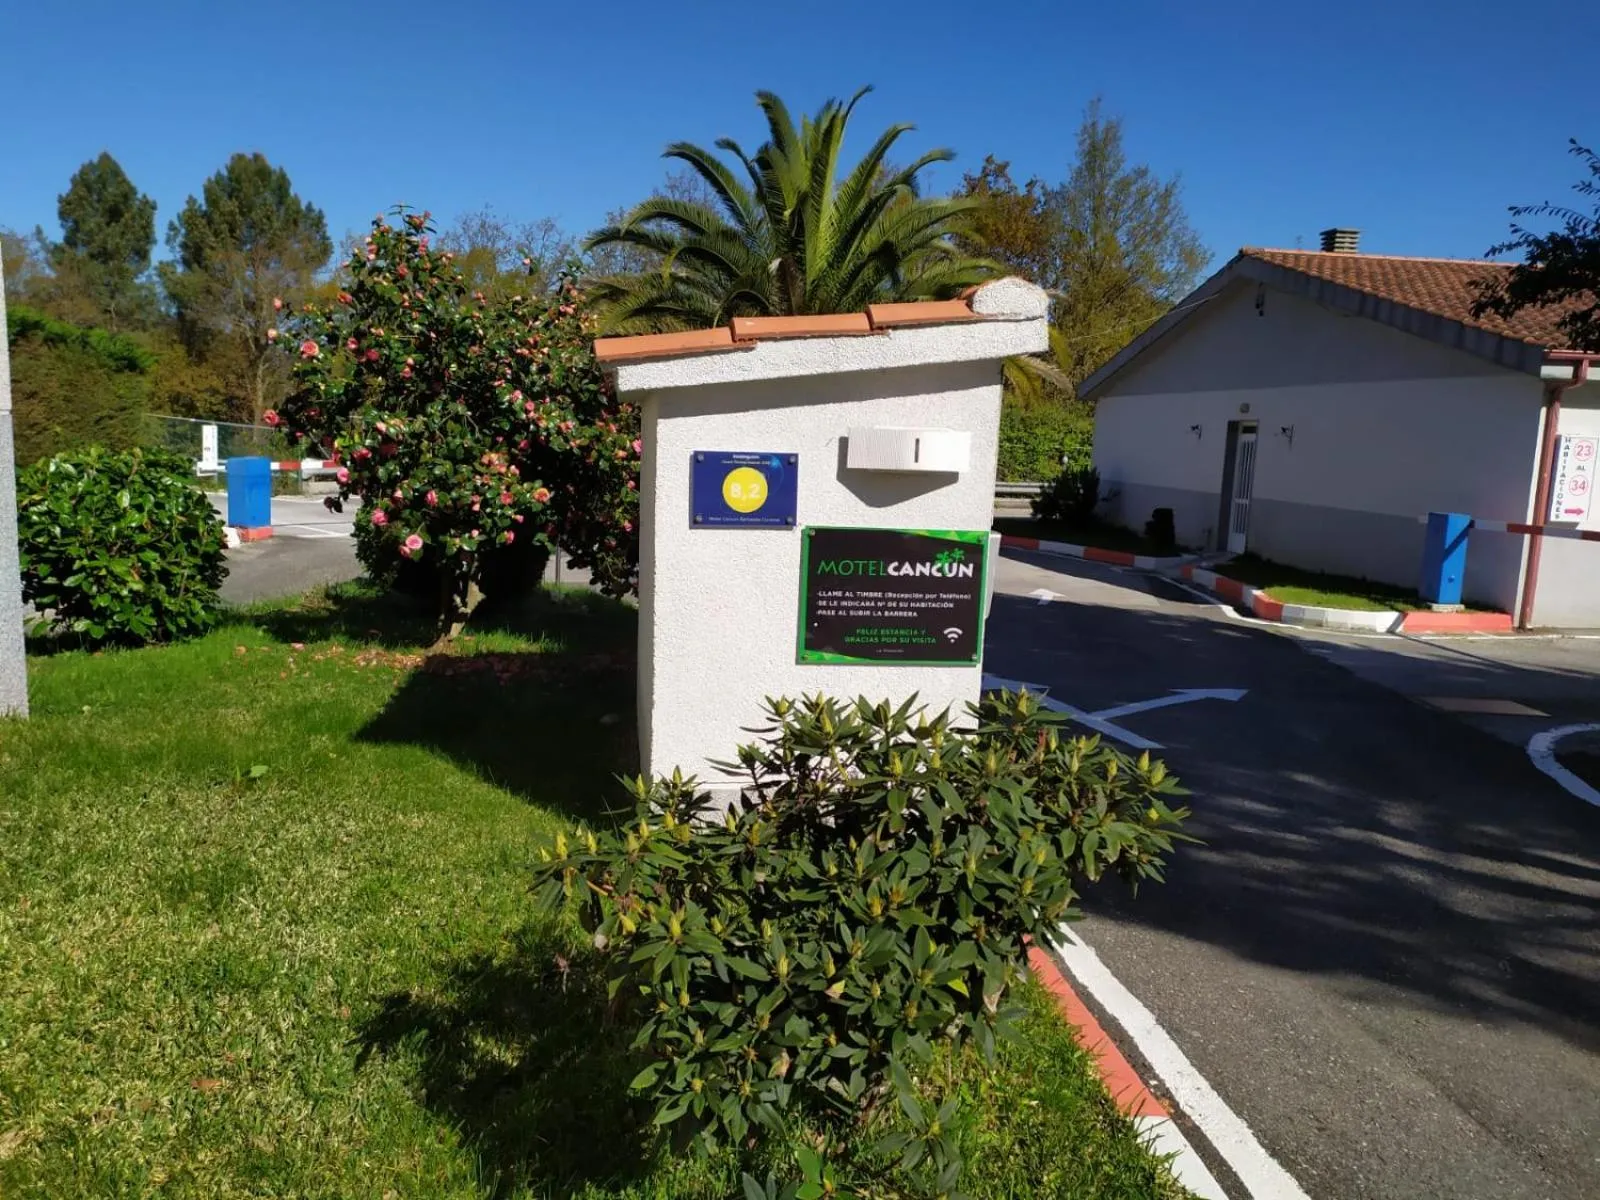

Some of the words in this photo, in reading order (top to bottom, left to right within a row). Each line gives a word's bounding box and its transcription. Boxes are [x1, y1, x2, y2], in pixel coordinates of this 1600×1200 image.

[1576, 445, 1591, 457] 23
[1555, 437, 1571, 519] HABITACIONES
[1571, 480, 1585, 491] 34
